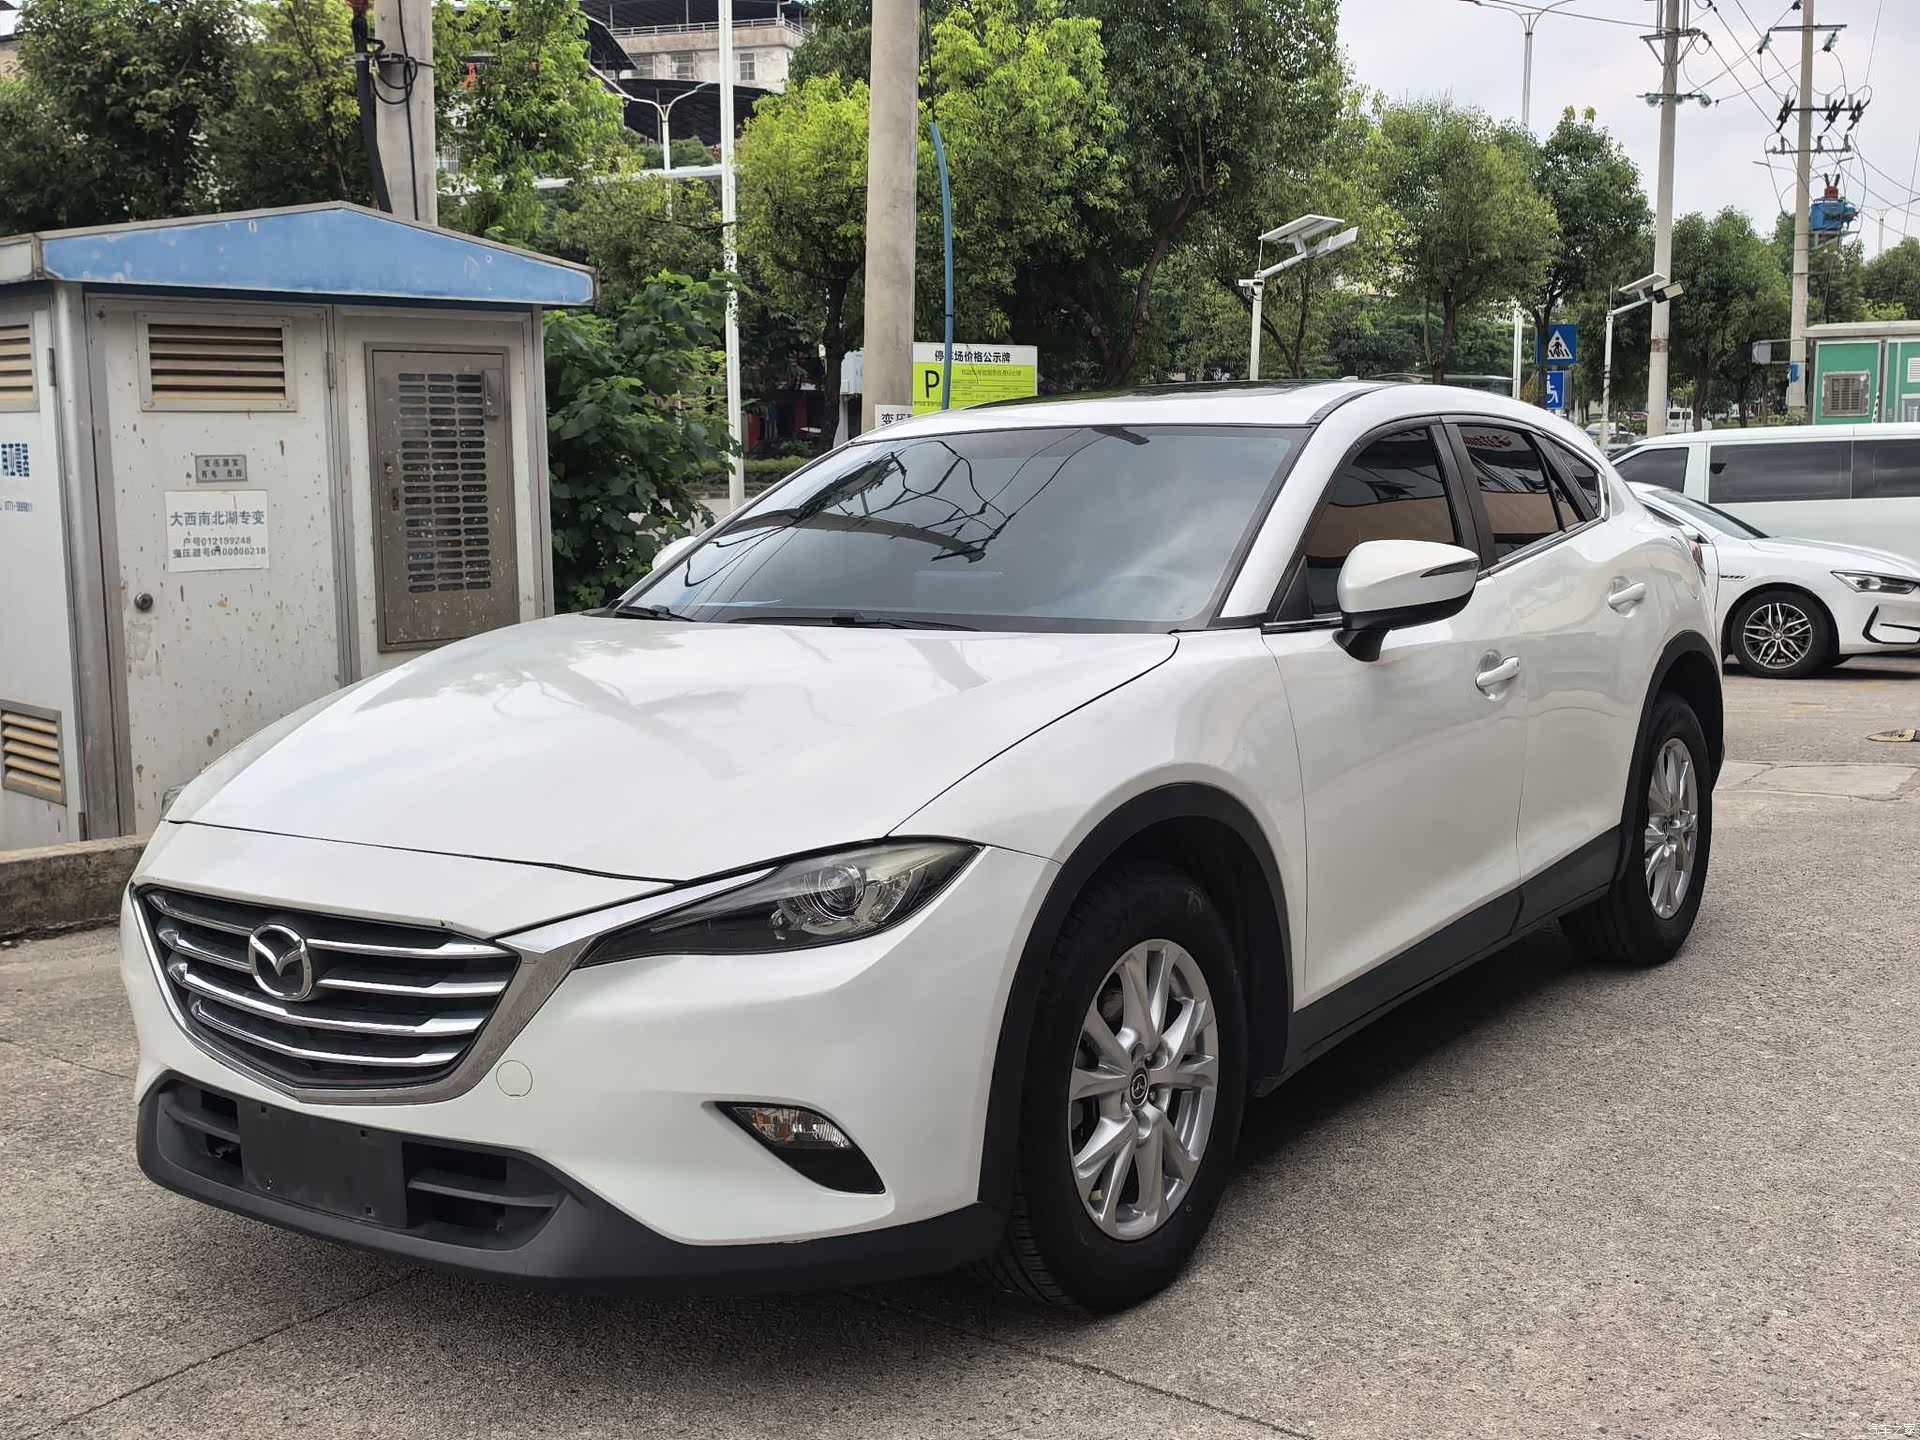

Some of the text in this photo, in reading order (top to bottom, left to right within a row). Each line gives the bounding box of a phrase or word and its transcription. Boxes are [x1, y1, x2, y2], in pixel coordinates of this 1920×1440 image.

[935, 350, 1011, 363] 停场价格公示牌
[925, 370, 940, 399] P
[170, 510, 265, 527] 大西南北湖专变
